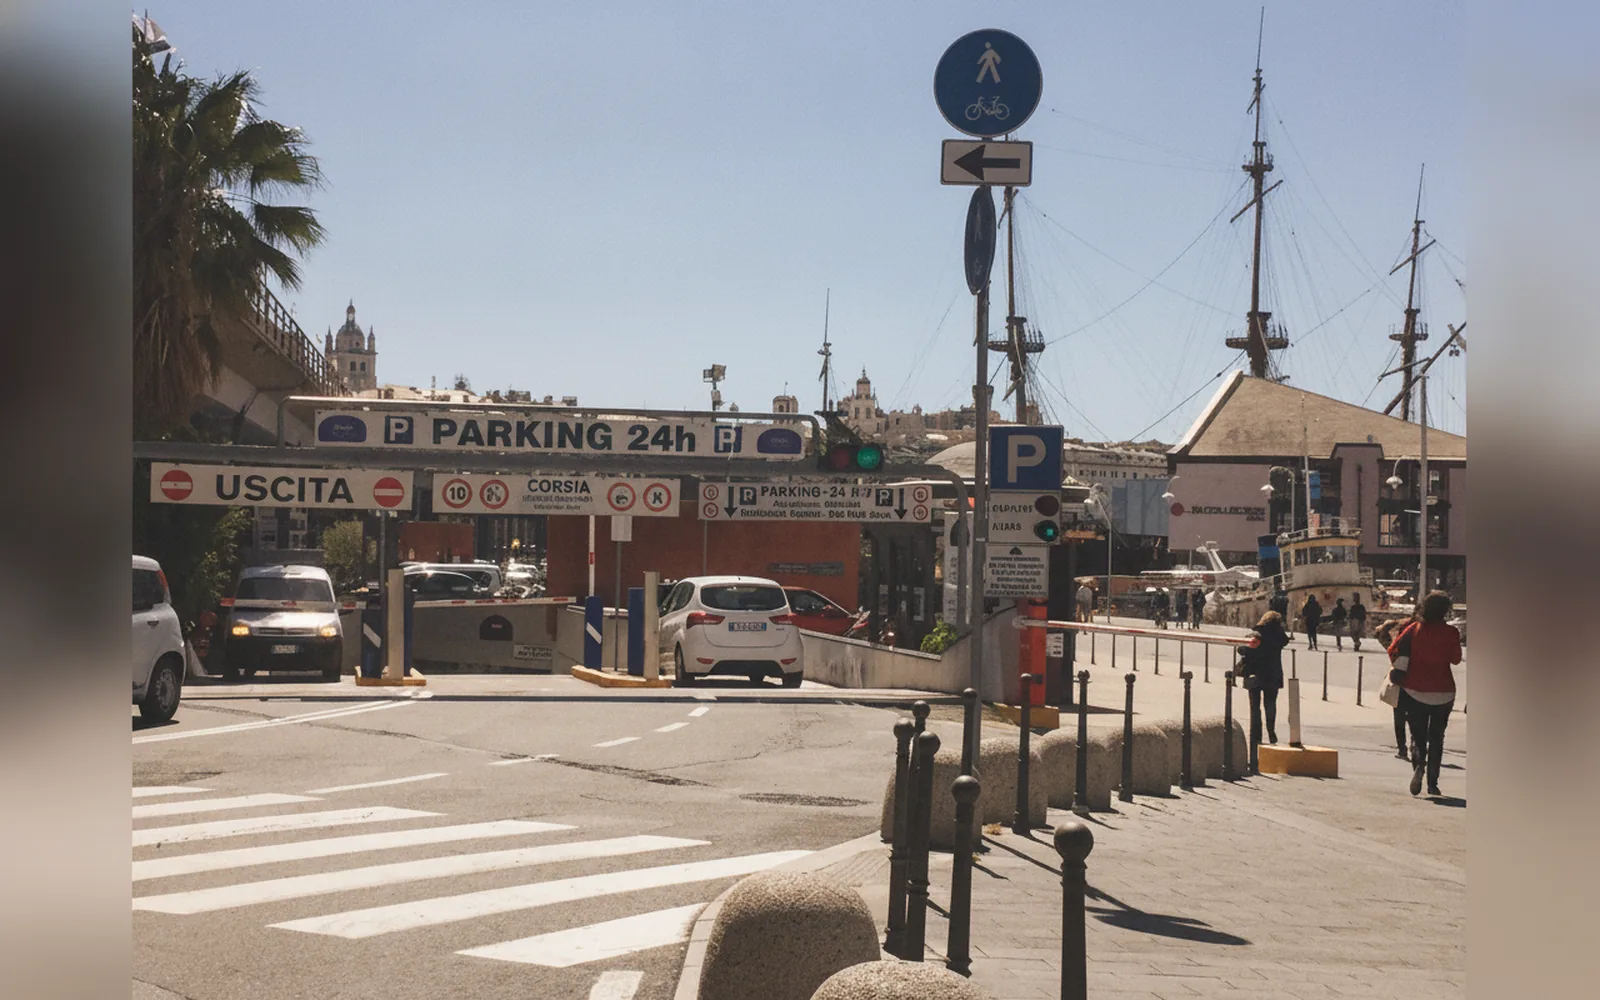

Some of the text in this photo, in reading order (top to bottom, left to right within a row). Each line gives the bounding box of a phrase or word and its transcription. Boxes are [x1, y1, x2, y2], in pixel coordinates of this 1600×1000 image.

[432, 417, 612, 451] PARKING
[627, 424, 696, 452] 24h
[1007, 434, 1047, 483] P
[215, 474, 354, 504] USCITA
[449, 486, 466, 501] 10
[527, 479, 591, 494] CORSIA
